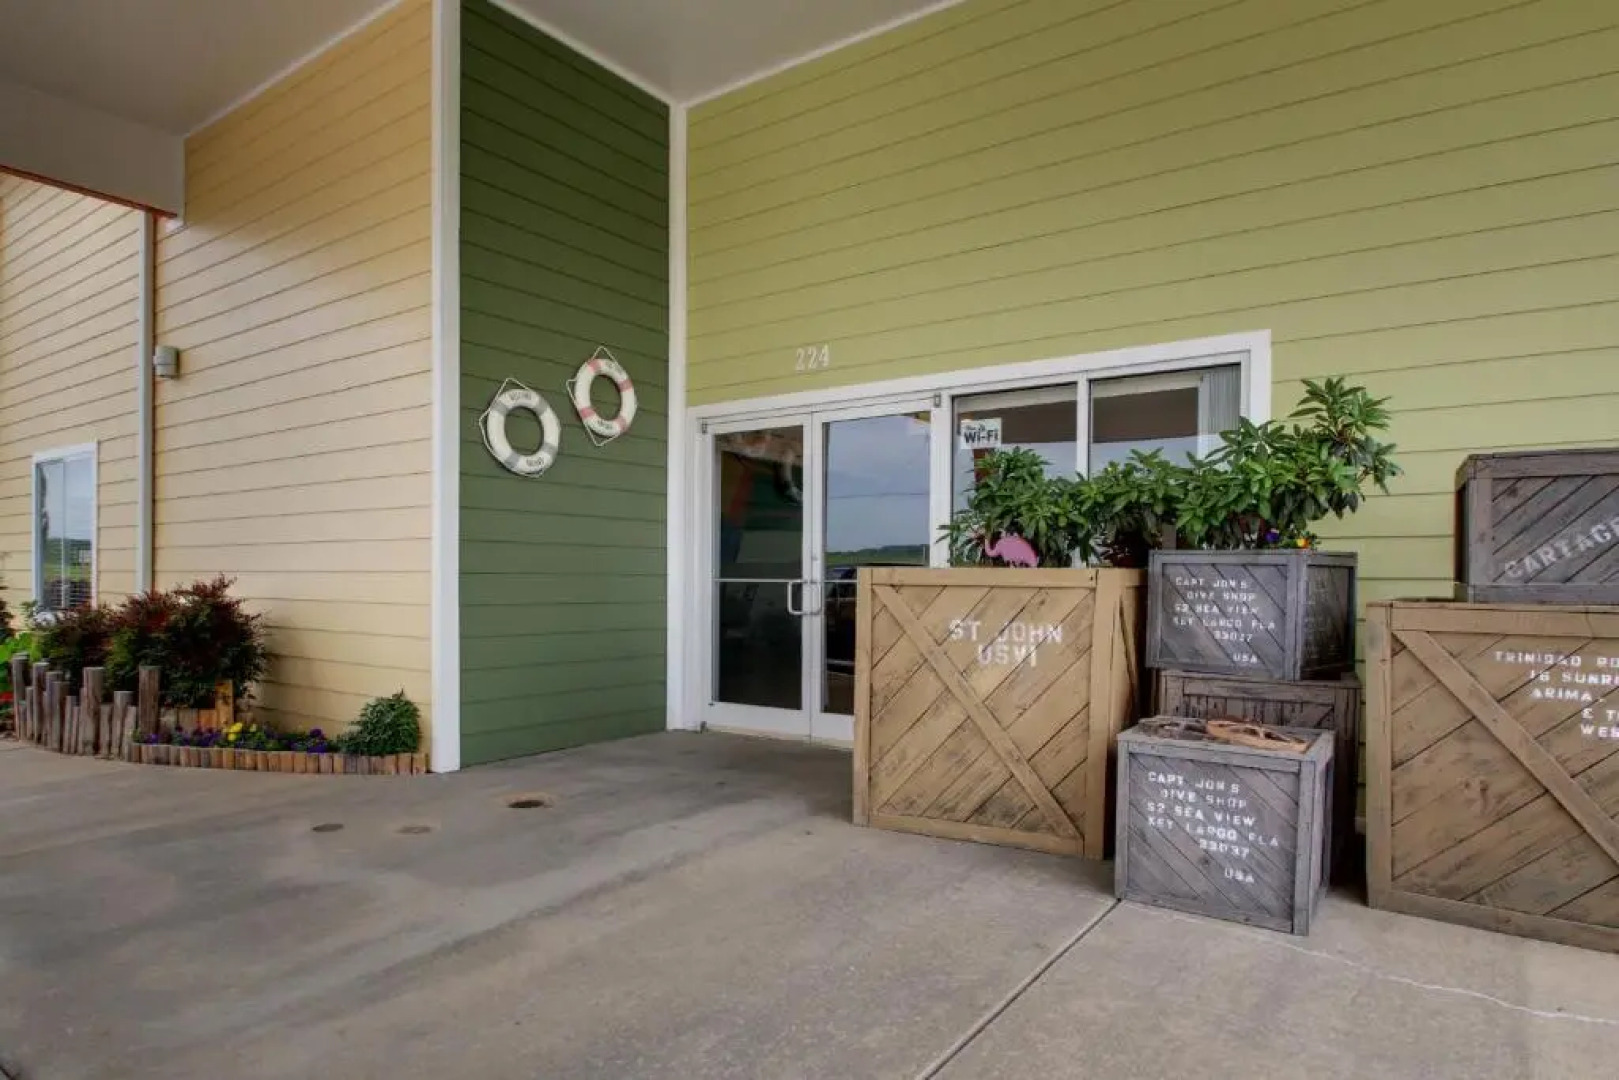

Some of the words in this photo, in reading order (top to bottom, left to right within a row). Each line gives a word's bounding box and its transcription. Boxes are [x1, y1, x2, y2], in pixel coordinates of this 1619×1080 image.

[795, 344, 829, 371] 224
[964, 428, 998, 443] Wi-Fi
[948, 619, 981, 641] ST
[998, 621, 1063, 644] JOHN
[977, 643, 1037, 668] USVI
[1232, 653, 1258, 664] USA
[1495, 651, 1582, 667] TRINIDAD
[1148, 771, 1184, 786] CAPT
[1160, 788, 1196, 803] DIVE
[1205, 794, 1247, 809] SHOP
[1174, 805, 1204, 821] SEA
[1213, 811, 1256, 828] VIEW
[1148, 815, 1174, 830] KEY
[1248, 832, 1279, 847] FLA
[1224, 867, 1255, 884] USA
